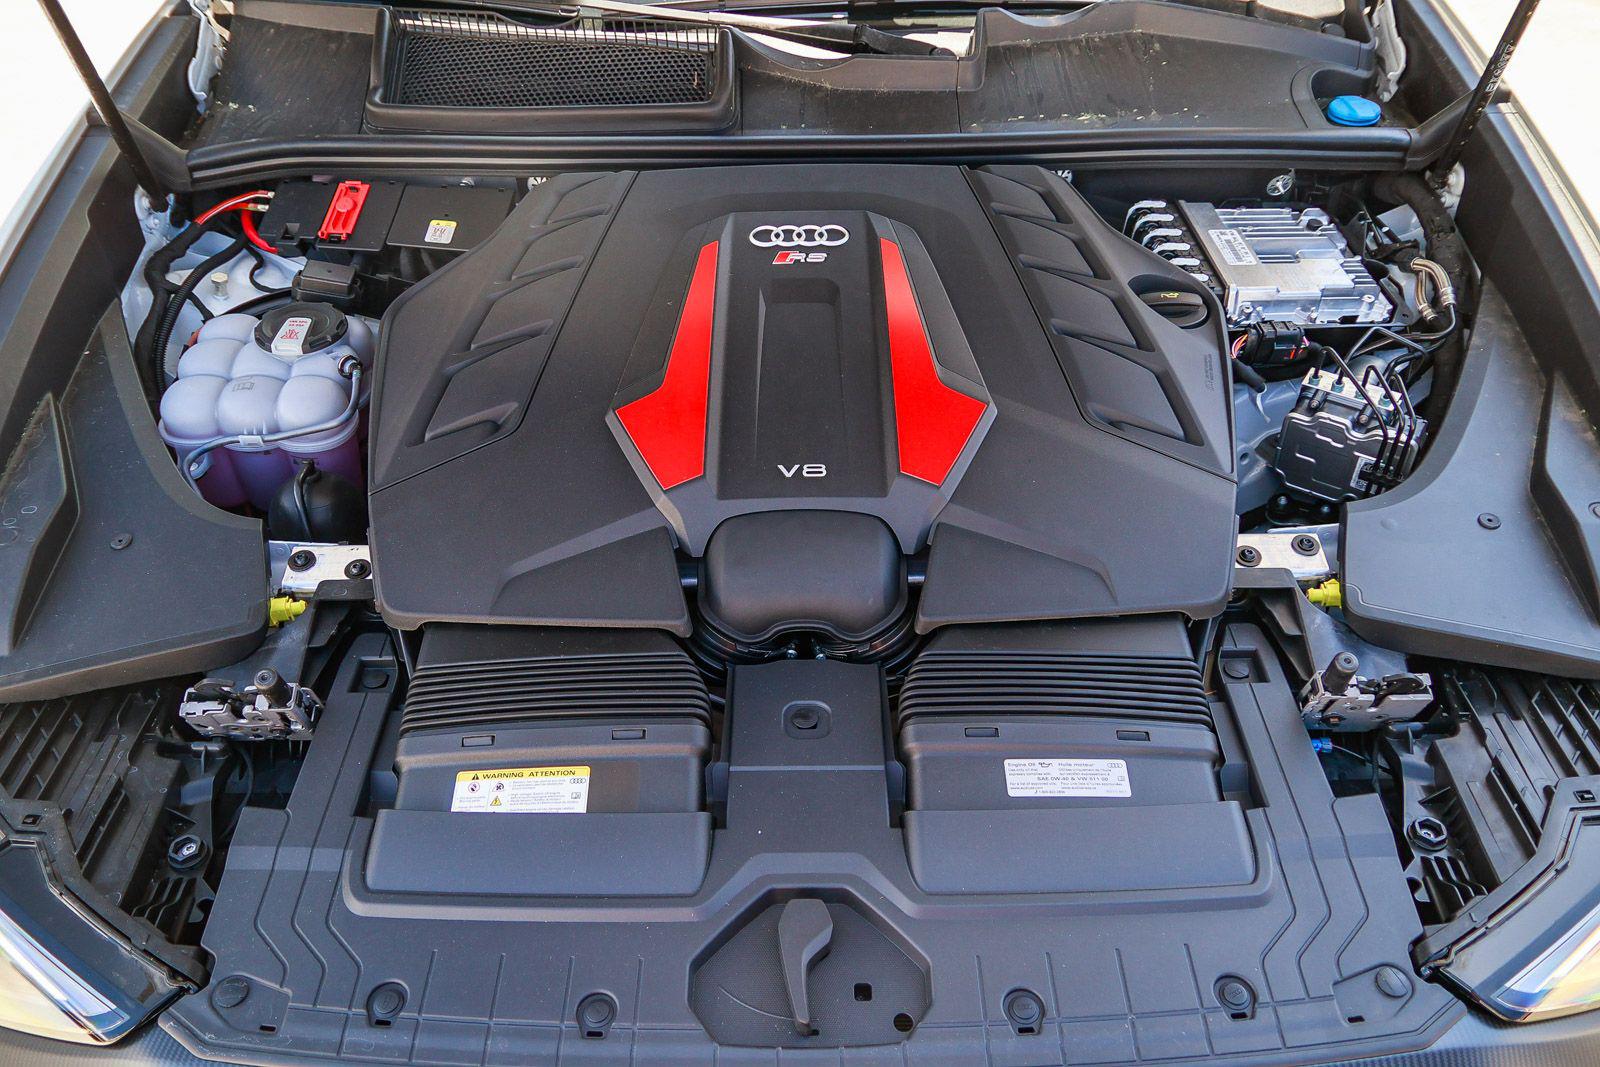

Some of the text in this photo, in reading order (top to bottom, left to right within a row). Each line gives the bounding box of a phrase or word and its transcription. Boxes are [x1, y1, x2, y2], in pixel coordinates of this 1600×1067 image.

[778, 251, 828, 264] RS
[777, 464, 827, 478] V8
[482, 769, 576, 780] WARNING ATTENTION
